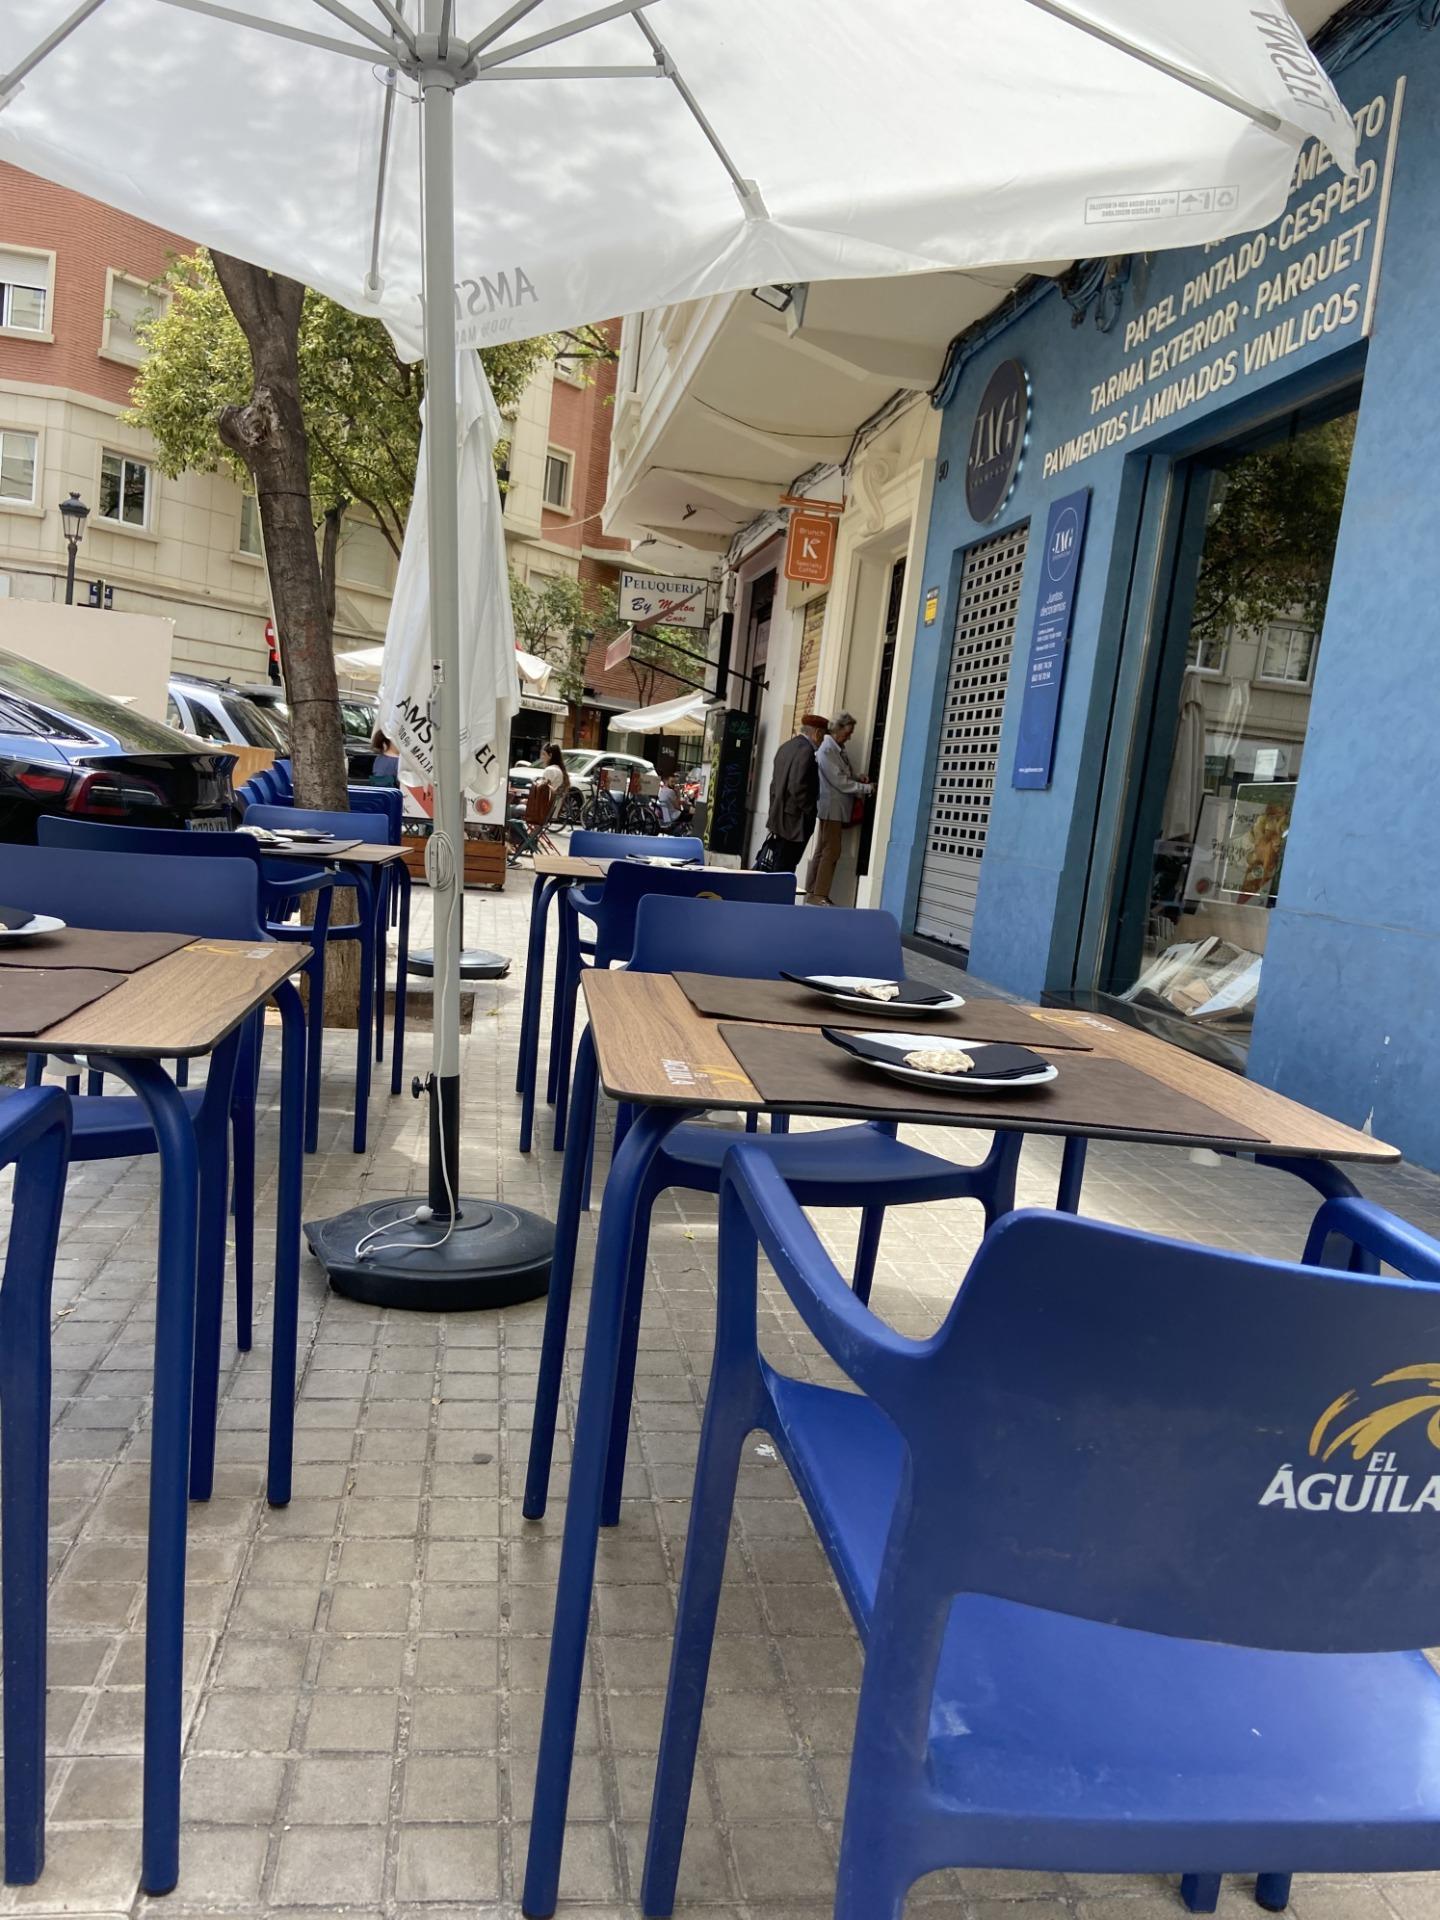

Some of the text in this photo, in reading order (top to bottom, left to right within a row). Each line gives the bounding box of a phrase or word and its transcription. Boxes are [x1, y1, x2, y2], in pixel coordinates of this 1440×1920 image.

[1091, 218, 1371, 414] TARIMA EXTERIOR PARQUET
[1124, 294, 1177, 352] PAPEL
[1181, 233, 1267, 315] PINTADO
[1043, 283, 1361, 479] PAVIMENTOS LAMINADOS VINILICOS
[631, 597, 652, 614] By
[1258, 1463, 1440, 1513] ÁGUILA
[1367, 1451, 1397, 1472] EL
